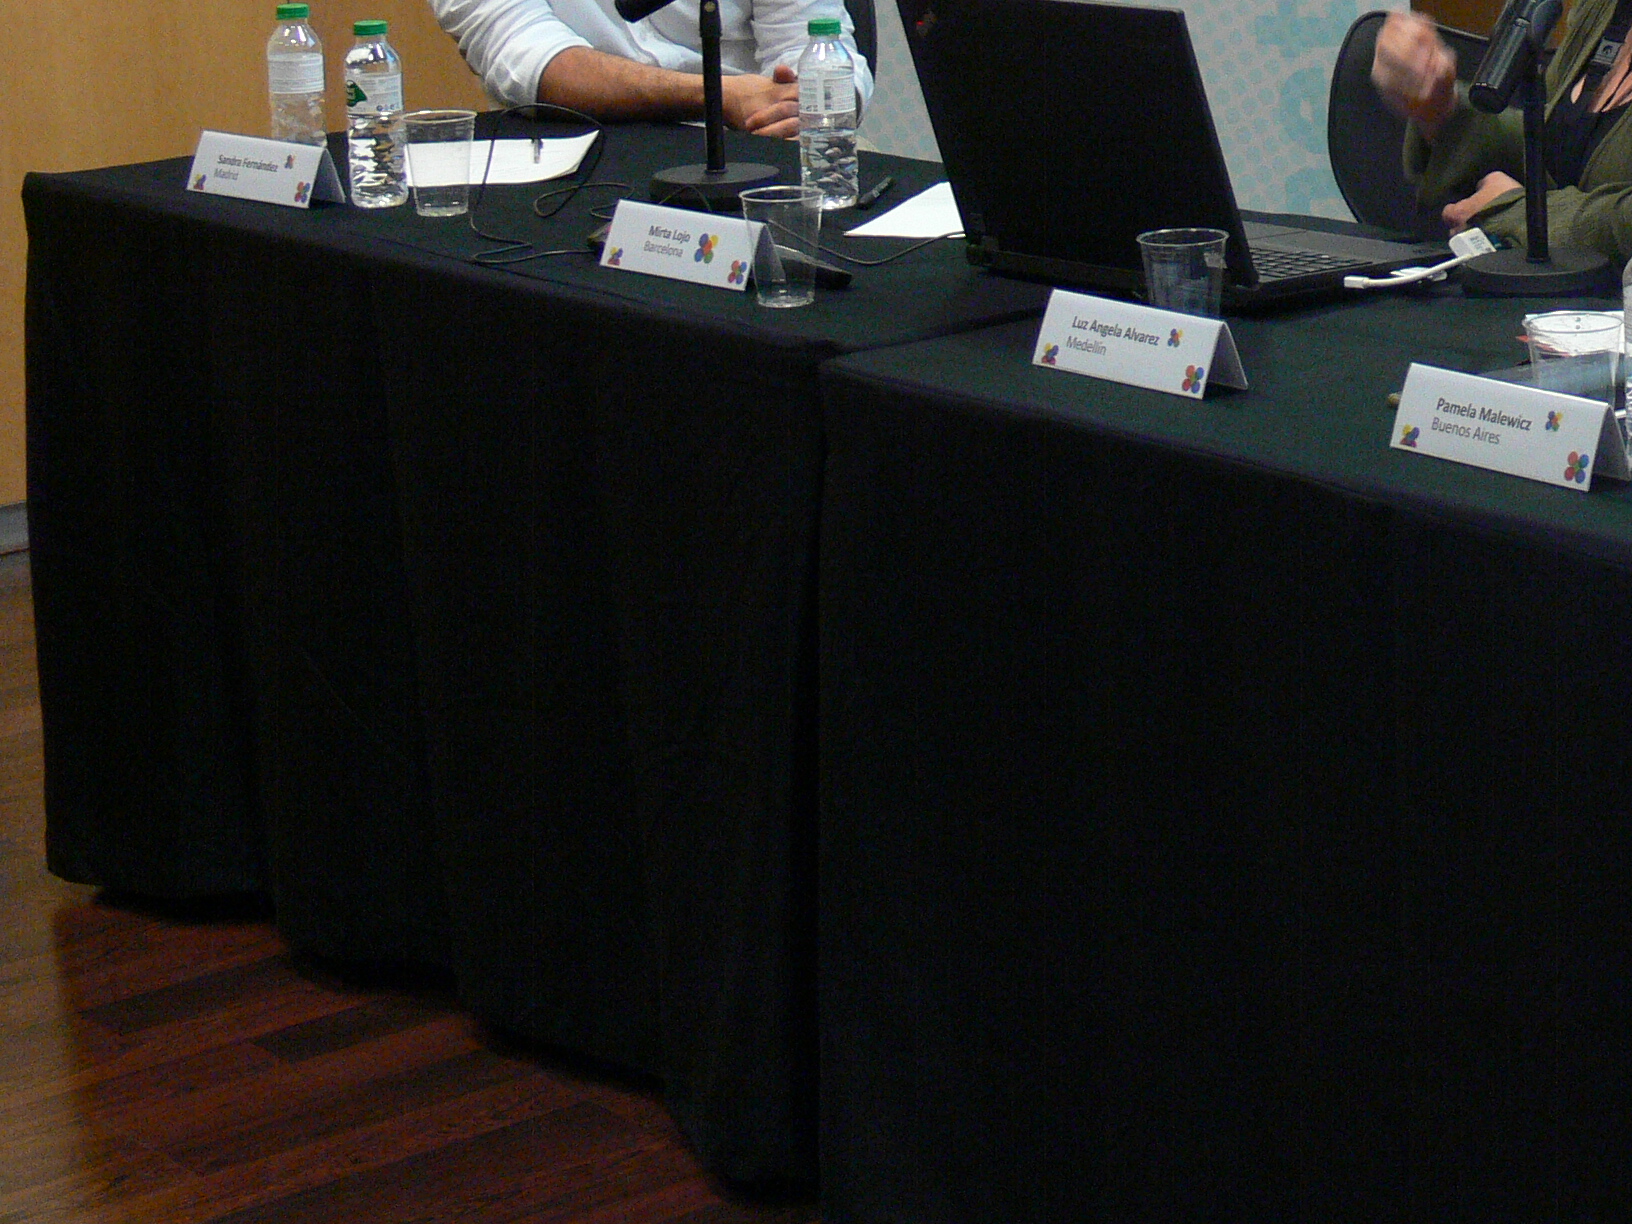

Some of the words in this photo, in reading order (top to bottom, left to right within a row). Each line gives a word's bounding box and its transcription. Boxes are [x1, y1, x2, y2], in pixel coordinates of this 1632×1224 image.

[648, 225, 672, 239] Mirta
[672, 229, 691, 244] Lojo
[643, 240, 684, 258] Barcelona
[1072, 316, 1089, 331] Luz
[1089, 320, 1122, 339] Angela
[1436, 398, 1477, 419] Pamela
[1478, 406, 1533, 432] Malewicz
[1431, 416, 1471, 439] Buenos
[1473, 428, 1501, 445] Aires
